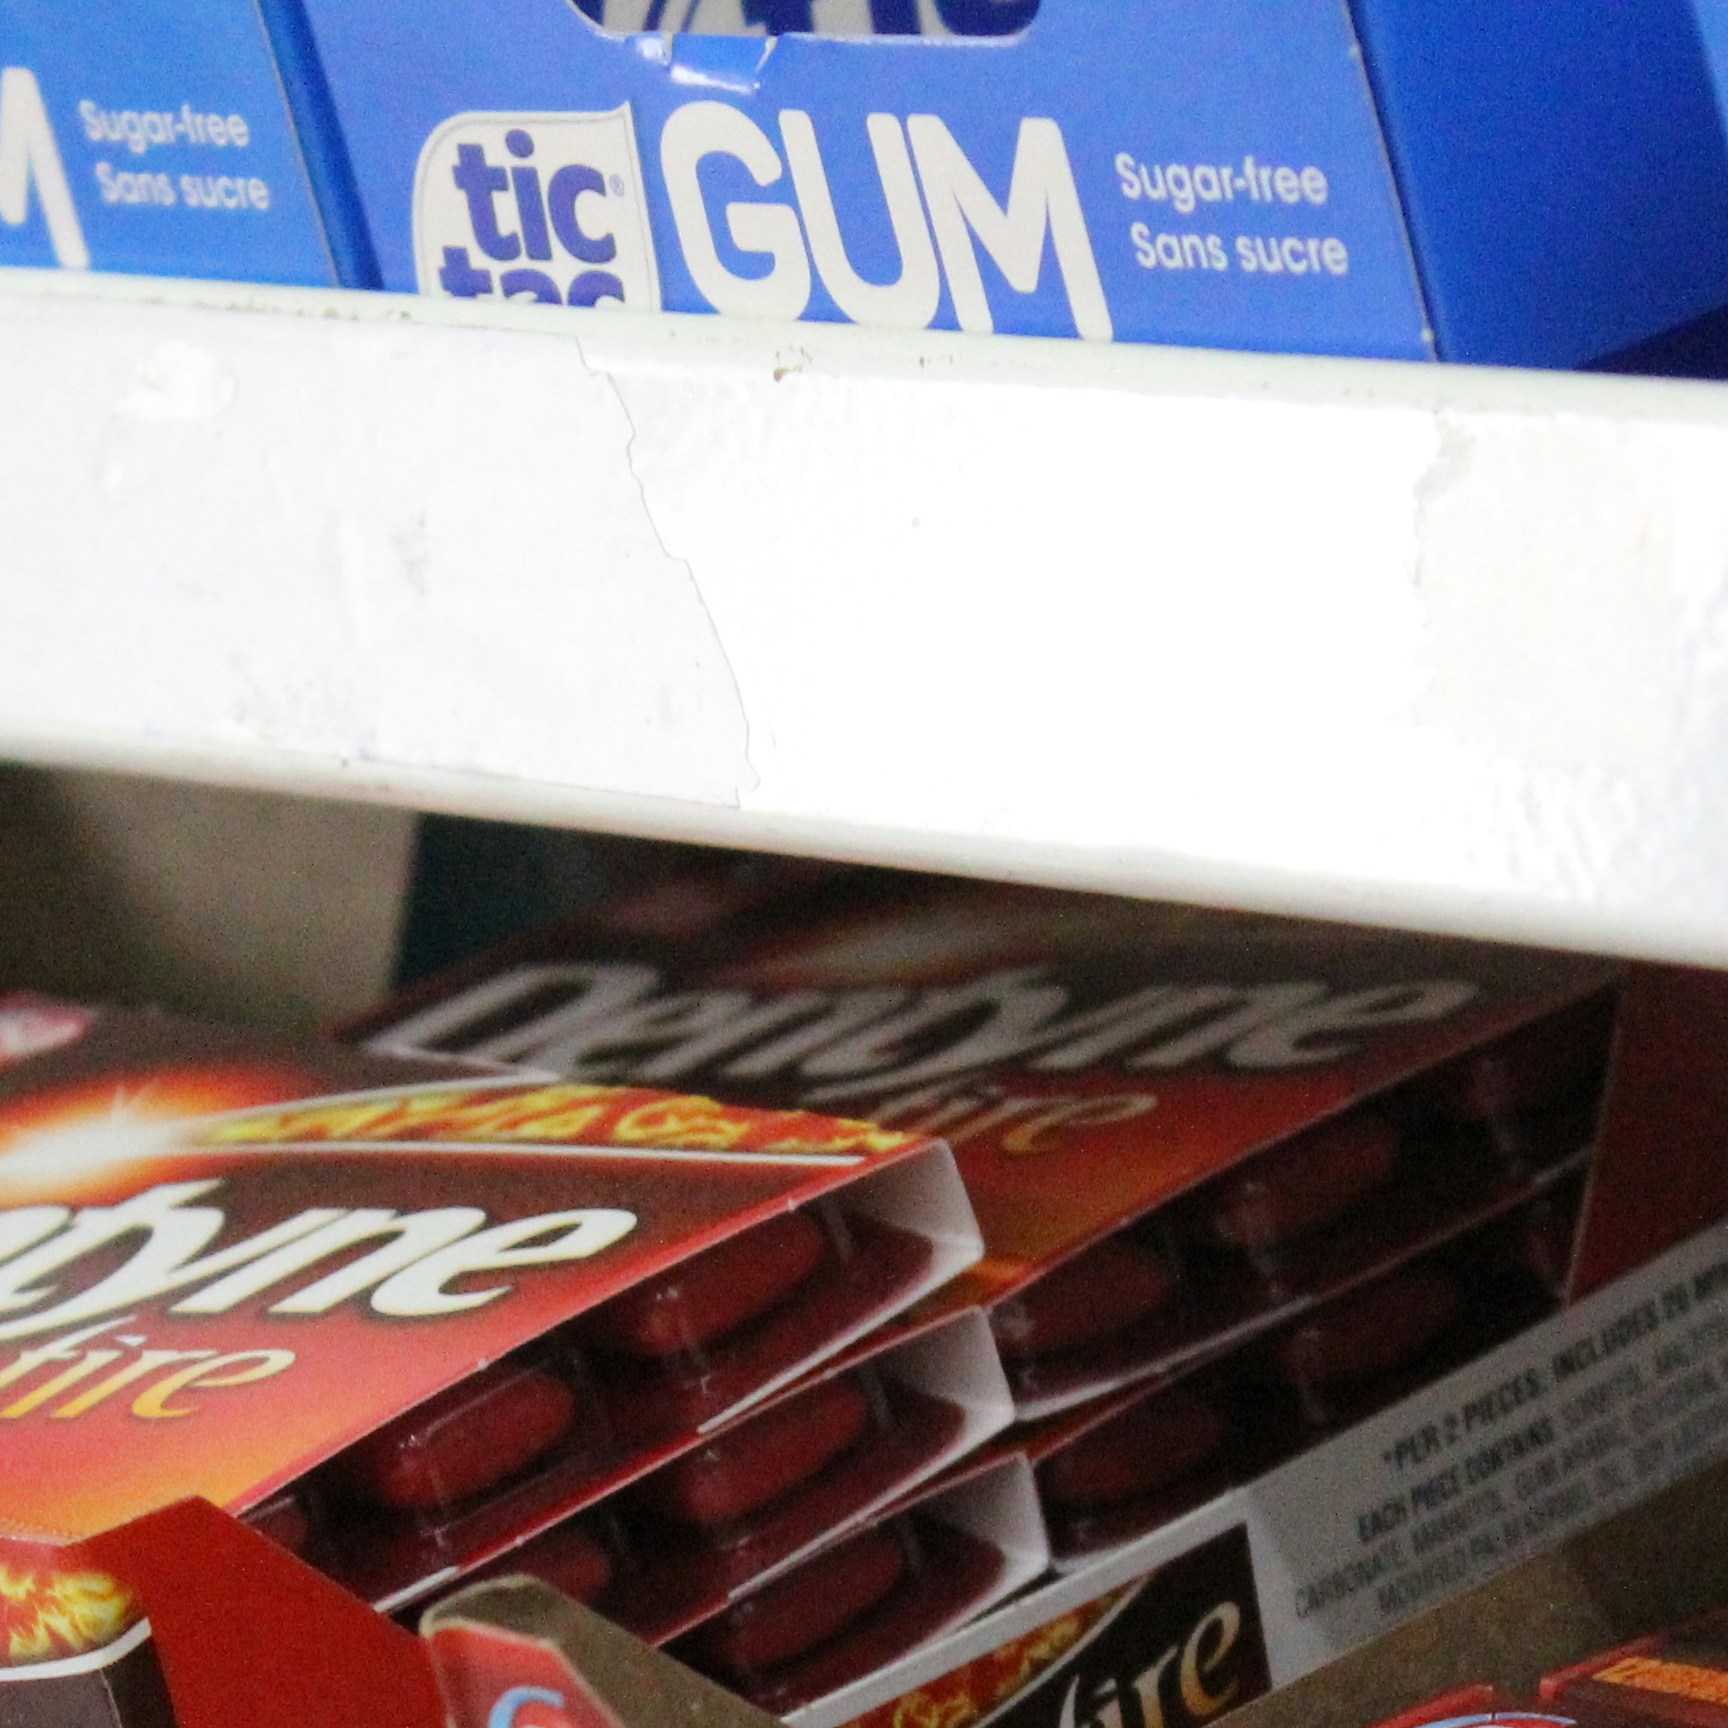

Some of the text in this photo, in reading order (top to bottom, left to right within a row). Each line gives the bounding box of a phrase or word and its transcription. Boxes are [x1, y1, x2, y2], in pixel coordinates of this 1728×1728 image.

[78, 100, 250, 153] Sugar-free
[95, 162, 270, 212] Sans sucre
[453, 130, 618, 265] tic
[1114, 152, 1328, 212] Sugar-free
[659, 99, 1113, 342] GUM
[1131, 221, 1350, 276] Sans sucre
[361, 960, 1484, 1103] Dentyne
